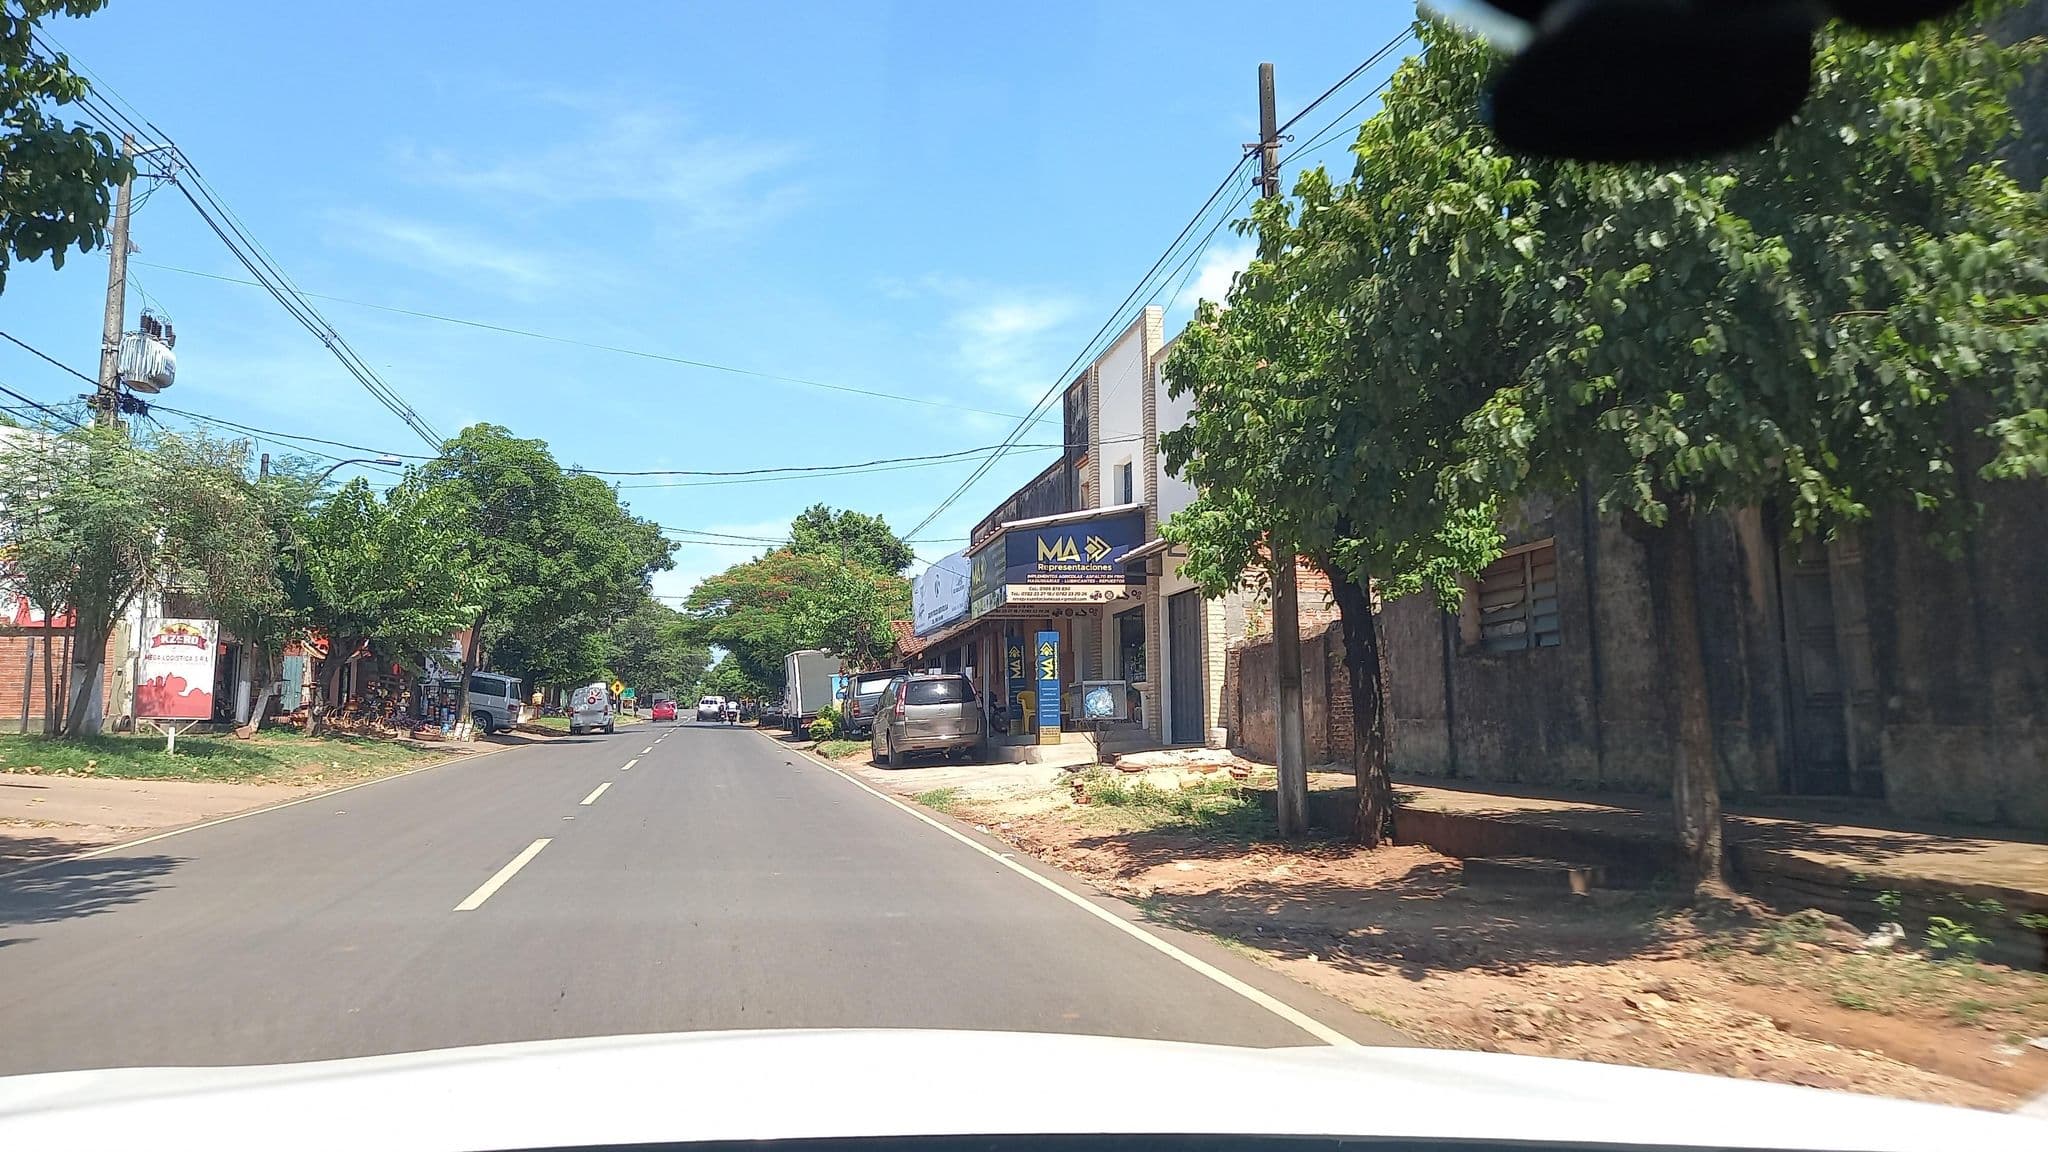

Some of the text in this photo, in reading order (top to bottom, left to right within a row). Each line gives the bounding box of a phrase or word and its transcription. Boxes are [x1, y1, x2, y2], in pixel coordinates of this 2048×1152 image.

[1037, 535, 1081, 562] MA
[1038, 563, 1112, 572] Representaciones
[1010, 659, 1021, 679] MA
[1040, 657, 1054, 680] MA
